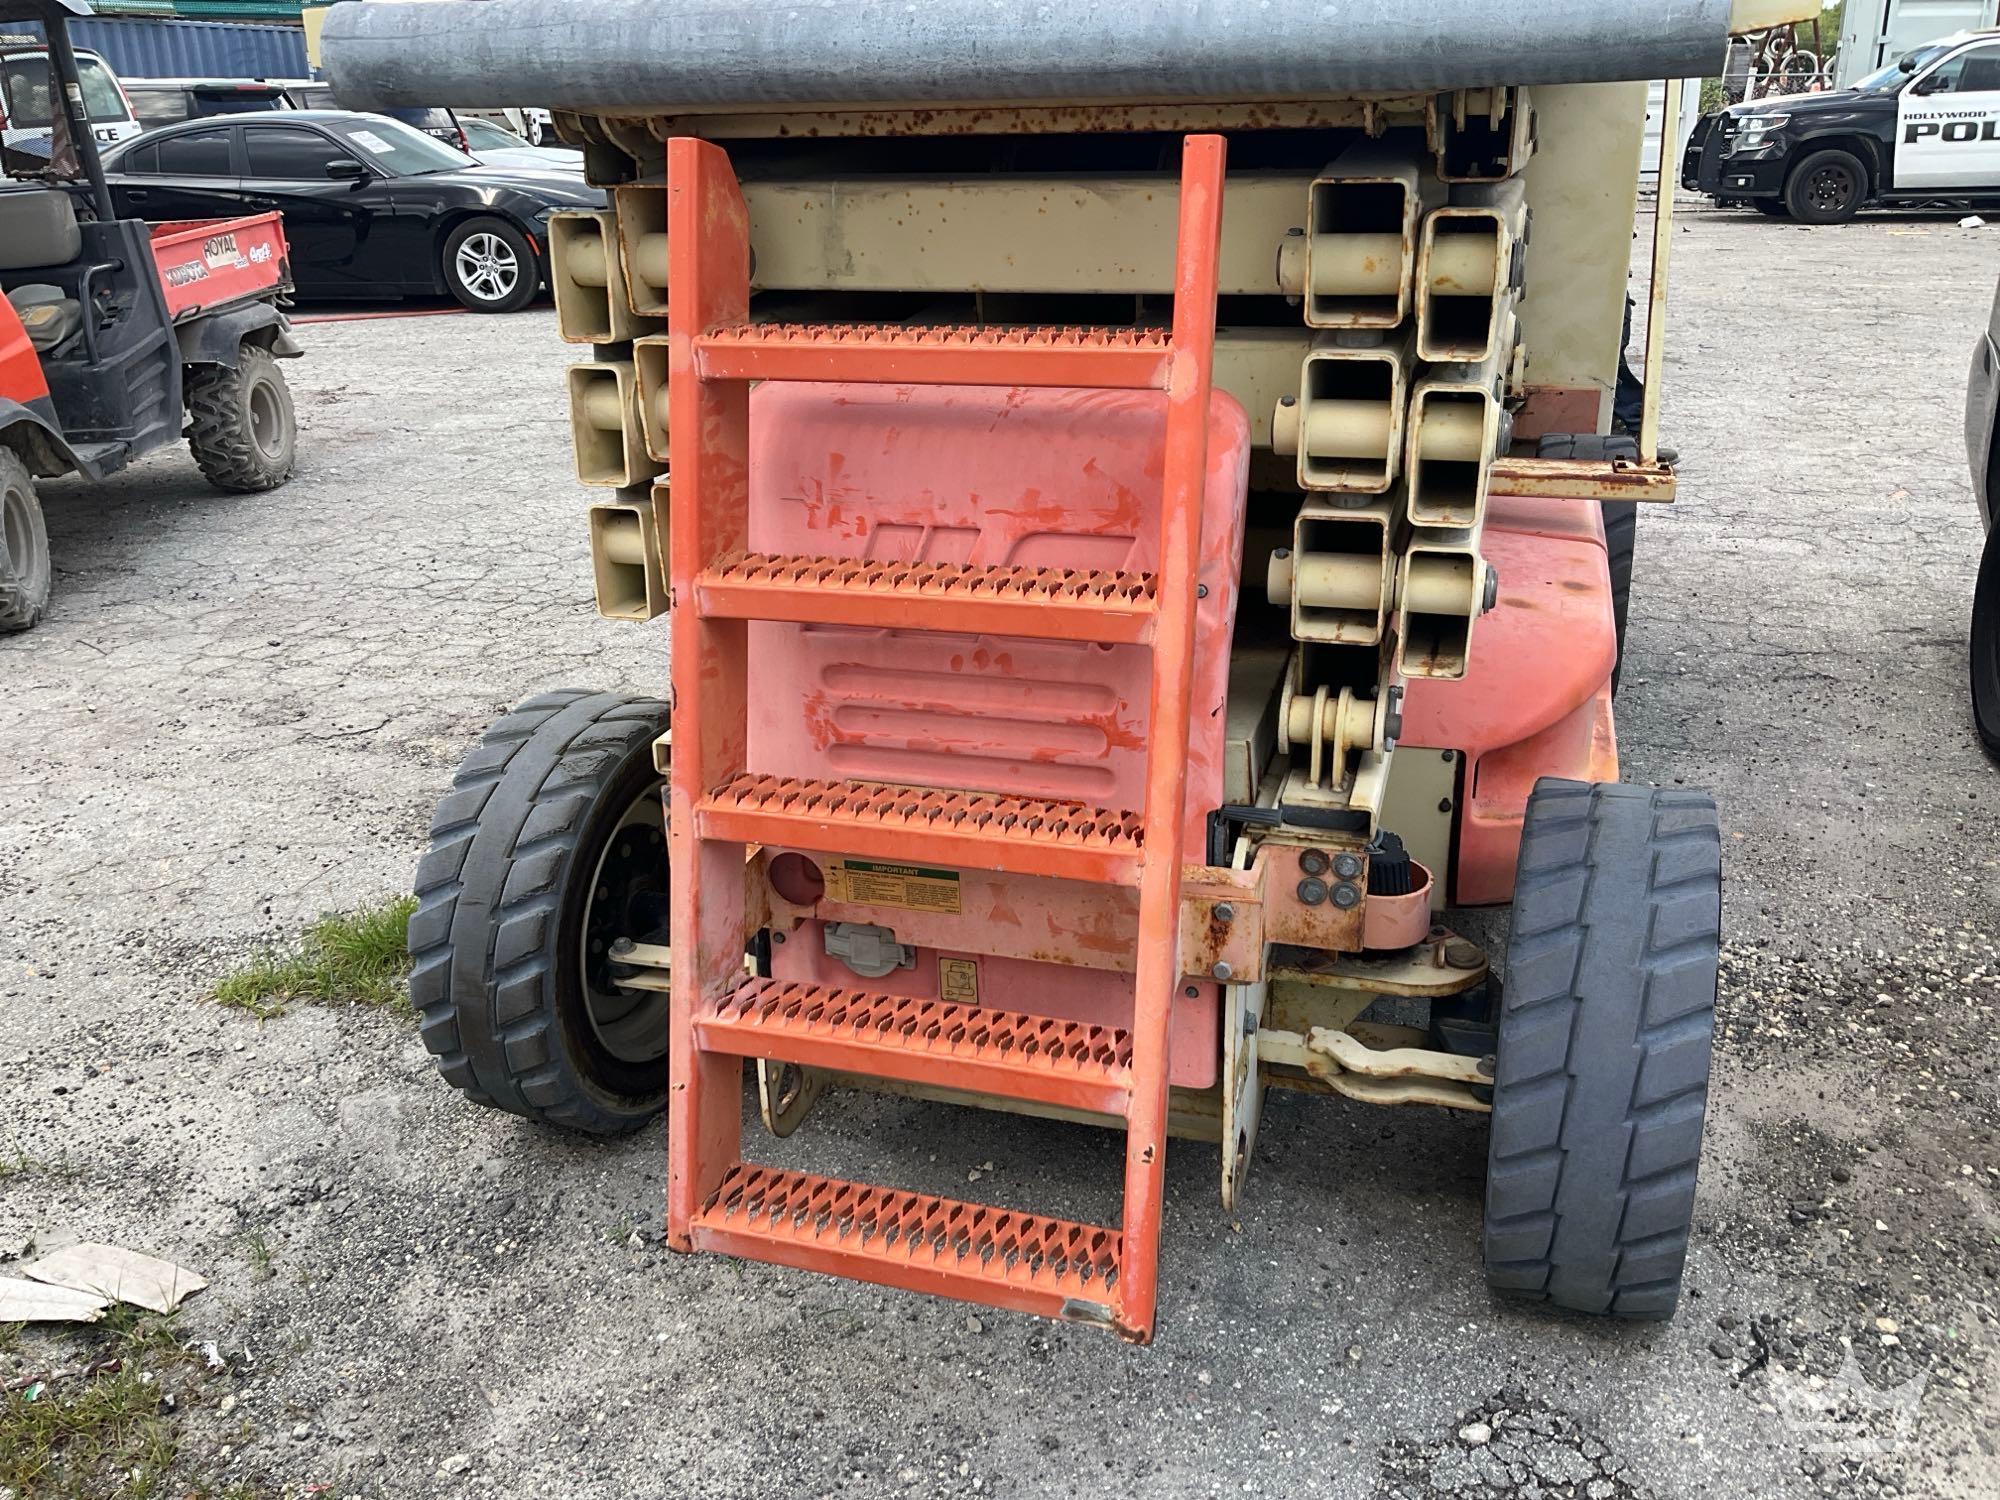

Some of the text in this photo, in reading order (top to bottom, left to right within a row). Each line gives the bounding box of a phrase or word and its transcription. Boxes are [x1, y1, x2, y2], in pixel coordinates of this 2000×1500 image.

[1903, 111, 1987, 120] HOLLYWOOD
[203, 235, 237, 259] ROYAL
[872, 865, 920, 876] IMPORTANT
